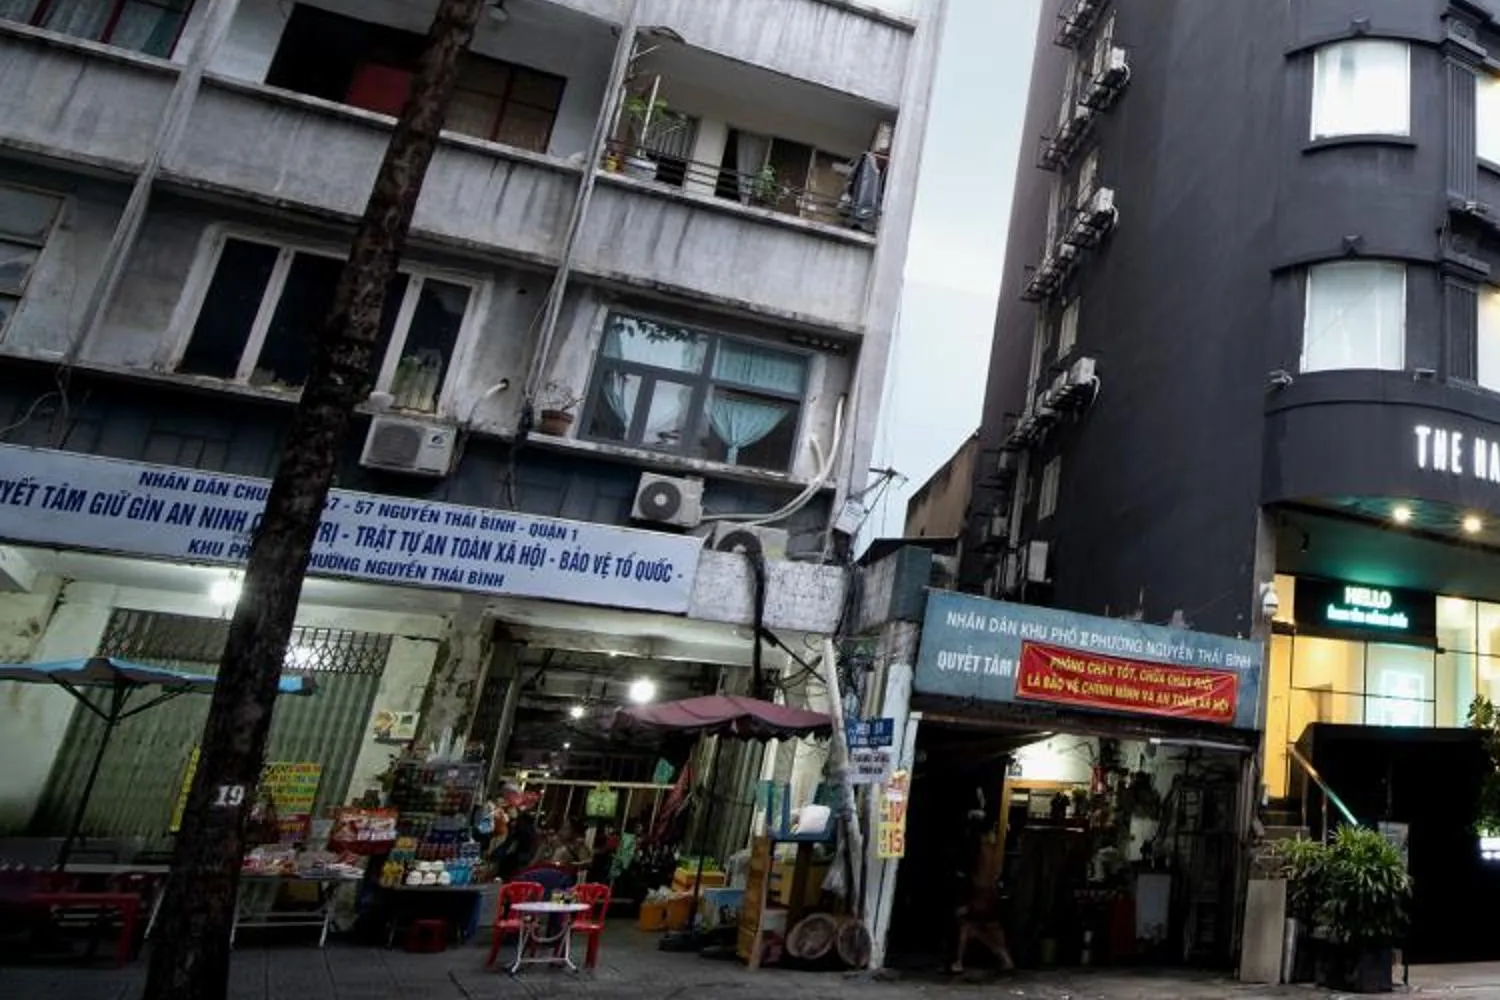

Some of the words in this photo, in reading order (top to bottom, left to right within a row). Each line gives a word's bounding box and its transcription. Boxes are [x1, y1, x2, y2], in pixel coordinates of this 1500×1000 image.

[1414, 424, 1462, 474] THE
[41, 482, 88, 513] TÂM
[89, 489, 130, 517] GIỮ
[127, 496, 161, 522] GÌN
[166, 502, 197, 526] AN
[198, 507, 248, 534] NINH
[355, 524, 396, 553] TRẬT
[400, 529, 424, 557] TỰ
[421, 534, 450, 555] AN
[451, 536, 491, 562] TOÀN
[518, 544, 547, 571] HỘI
[139, 471, 188, 491] NHÂN
[195, 476, 230, 497] DÂN
[233, 482, 270, 501] CHU
[354, 500, 375, 516] 57
[444, 510, 476, 530] THÁI
[571, 528, 578, 543] 1
[188, 538, 223, 557] KHU
[310, 549, 360, 572] HƯỜNG
[431, 567, 464, 583] THÁI
[946, 611, 986, 630] NHÂN
[988, 616, 1017, 635] DÂN
[1020, 621, 1047, 639] KHU
[213, 784, 245, 807] 19
